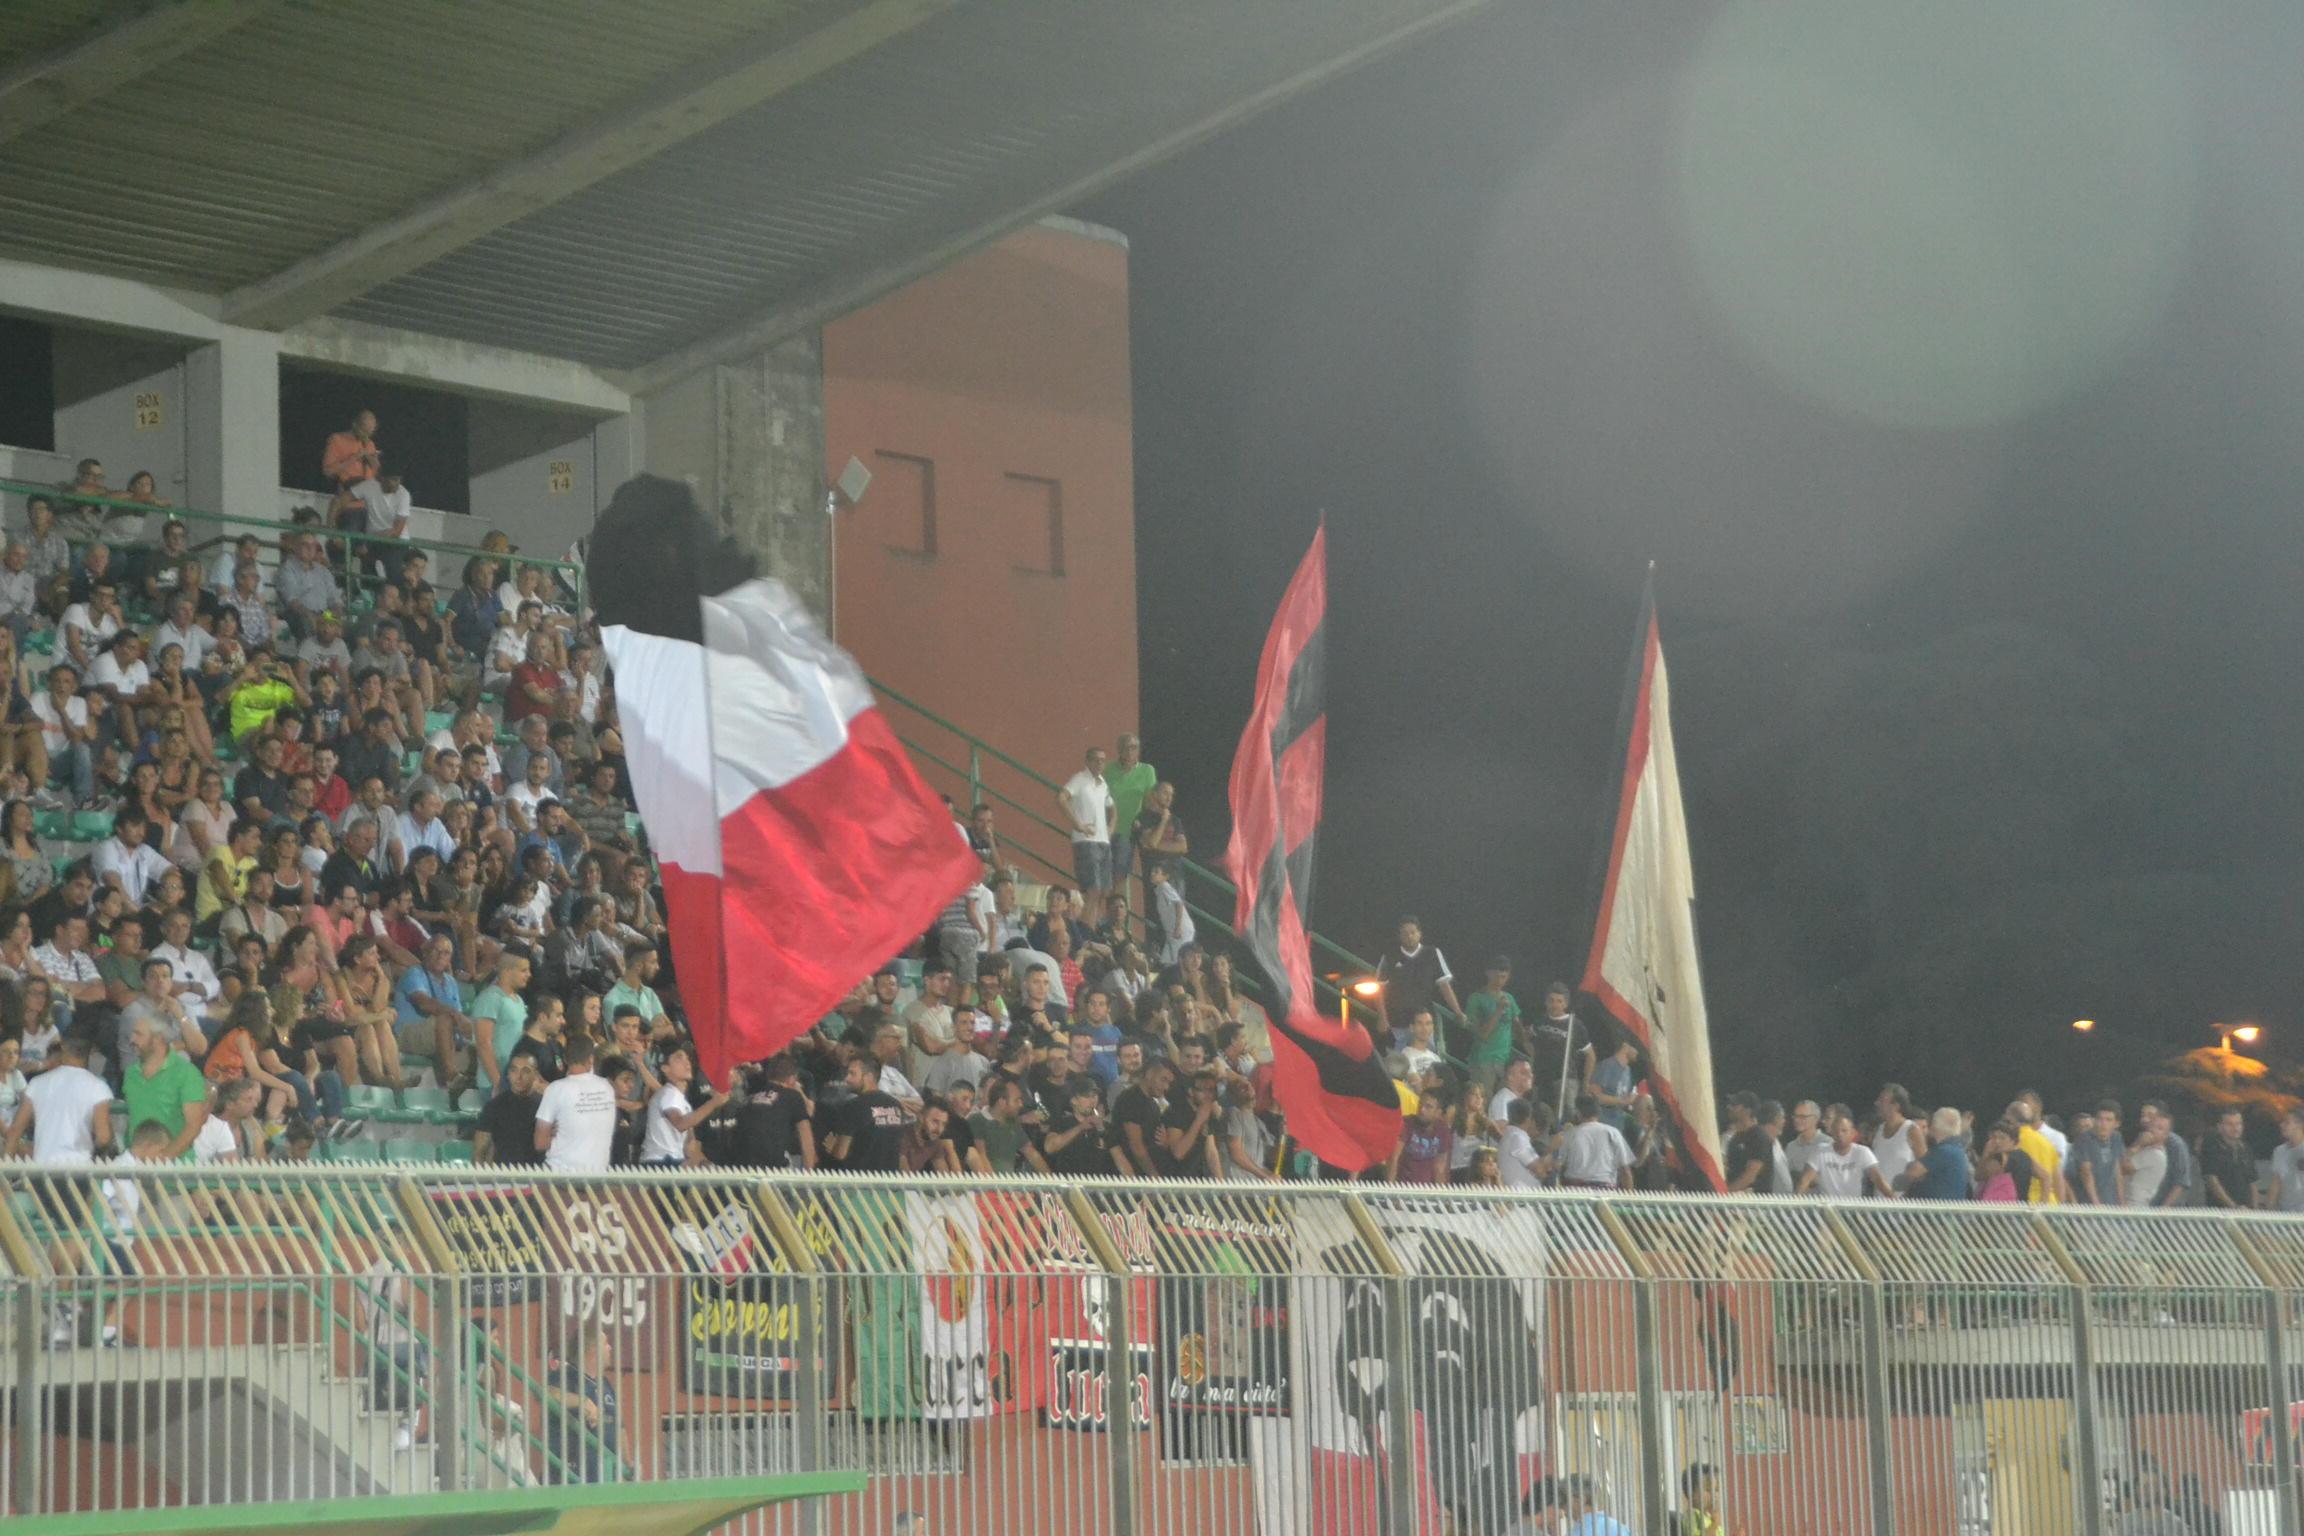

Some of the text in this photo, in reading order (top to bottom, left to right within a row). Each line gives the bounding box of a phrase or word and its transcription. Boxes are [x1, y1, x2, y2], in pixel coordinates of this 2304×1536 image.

[136, 392, 159, 408] BOX
[138, 411, 159, 424] 12
[550, 461, 571, 475] BOX
[552, 477, 570, 490] 14
[561, 1267, 647, 1327] 1905
